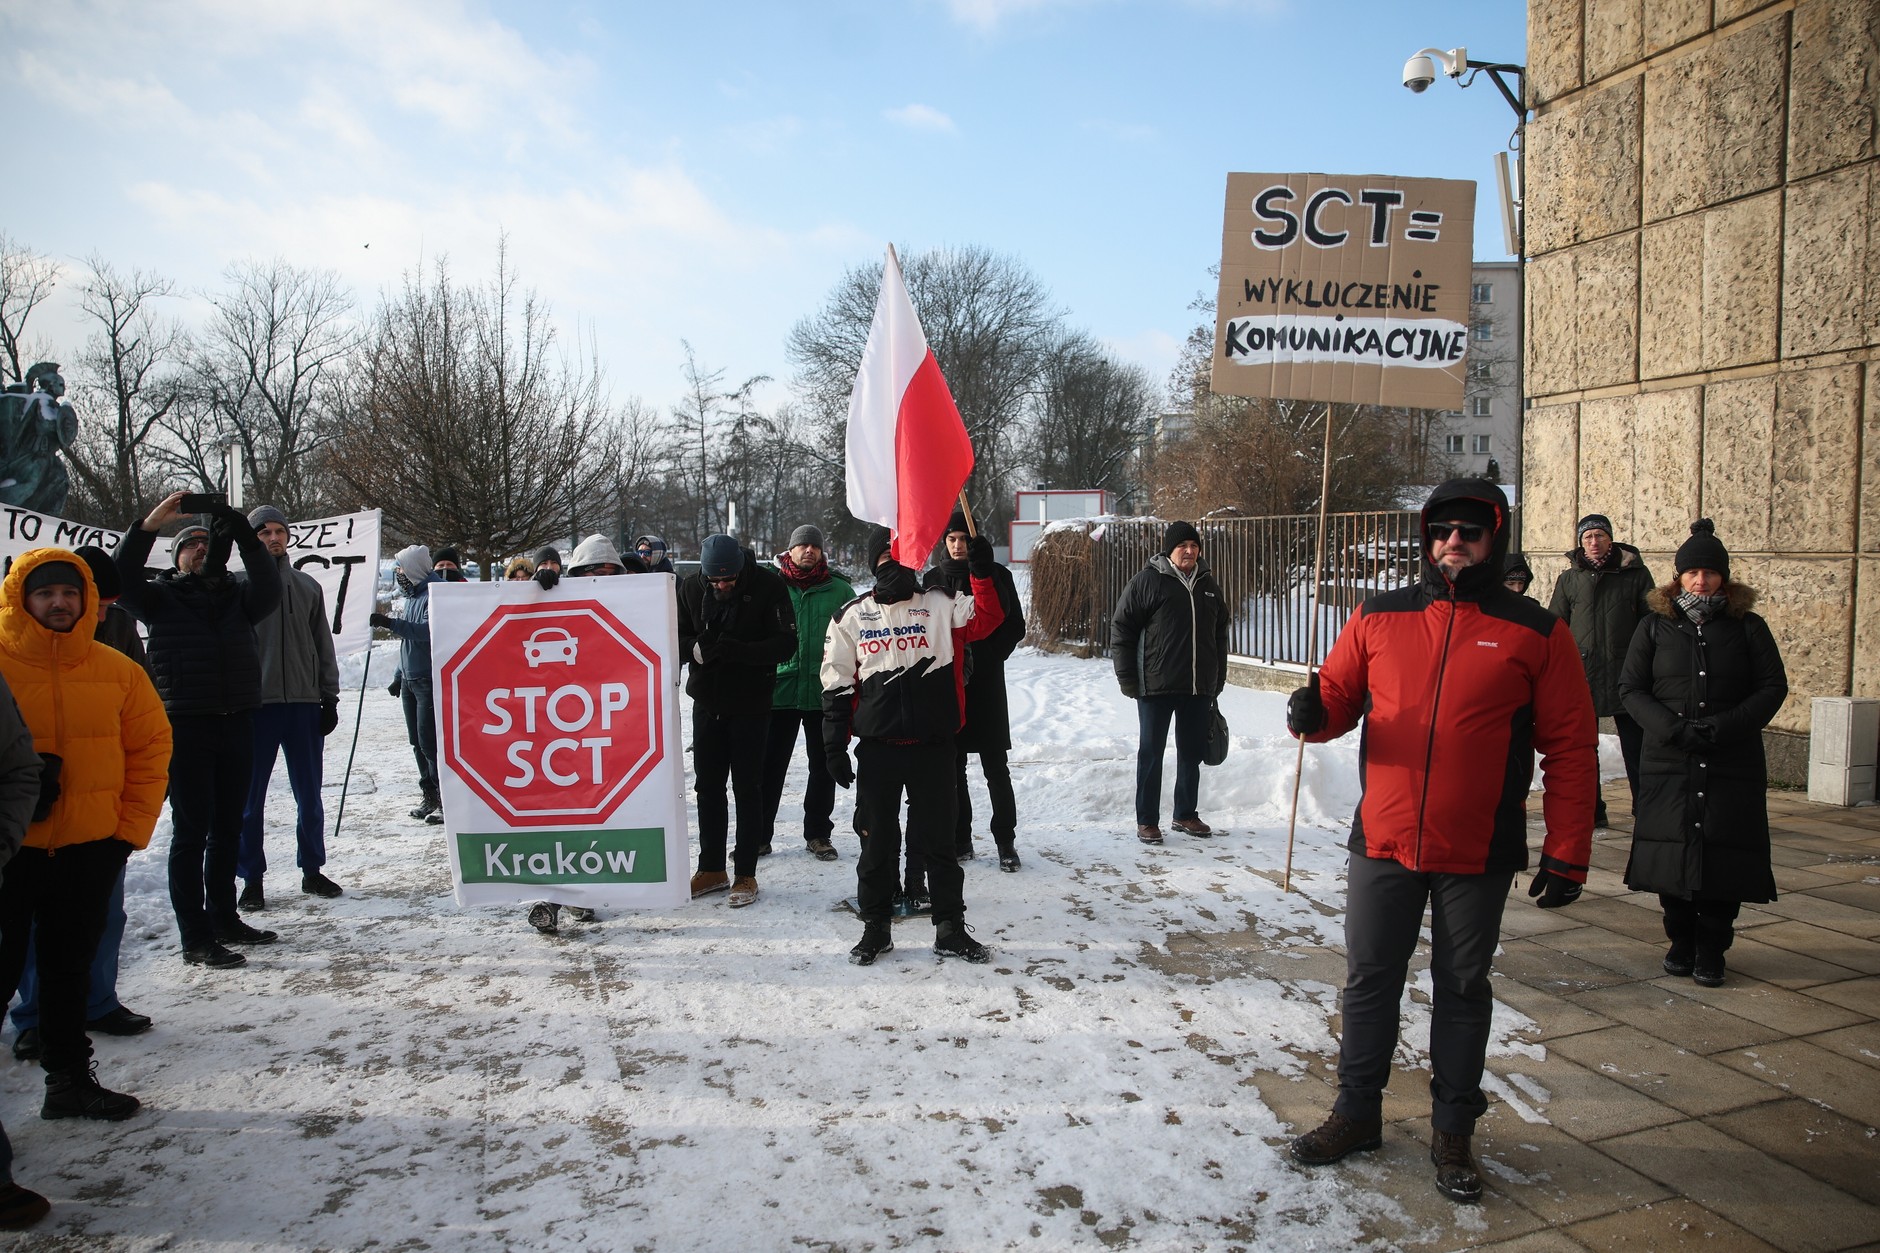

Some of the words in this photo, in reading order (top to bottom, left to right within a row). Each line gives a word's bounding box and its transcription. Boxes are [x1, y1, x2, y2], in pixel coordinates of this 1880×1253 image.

[4, 508, 43, 541] TO
[287, 518, 354, 549] SZE!
[859, 636, 929, 655] TOYOTA
[481, 682, 630, 735] STOP
[503, 737, 613, 788] SCT
[484, 840, 637, 877] Kraków
